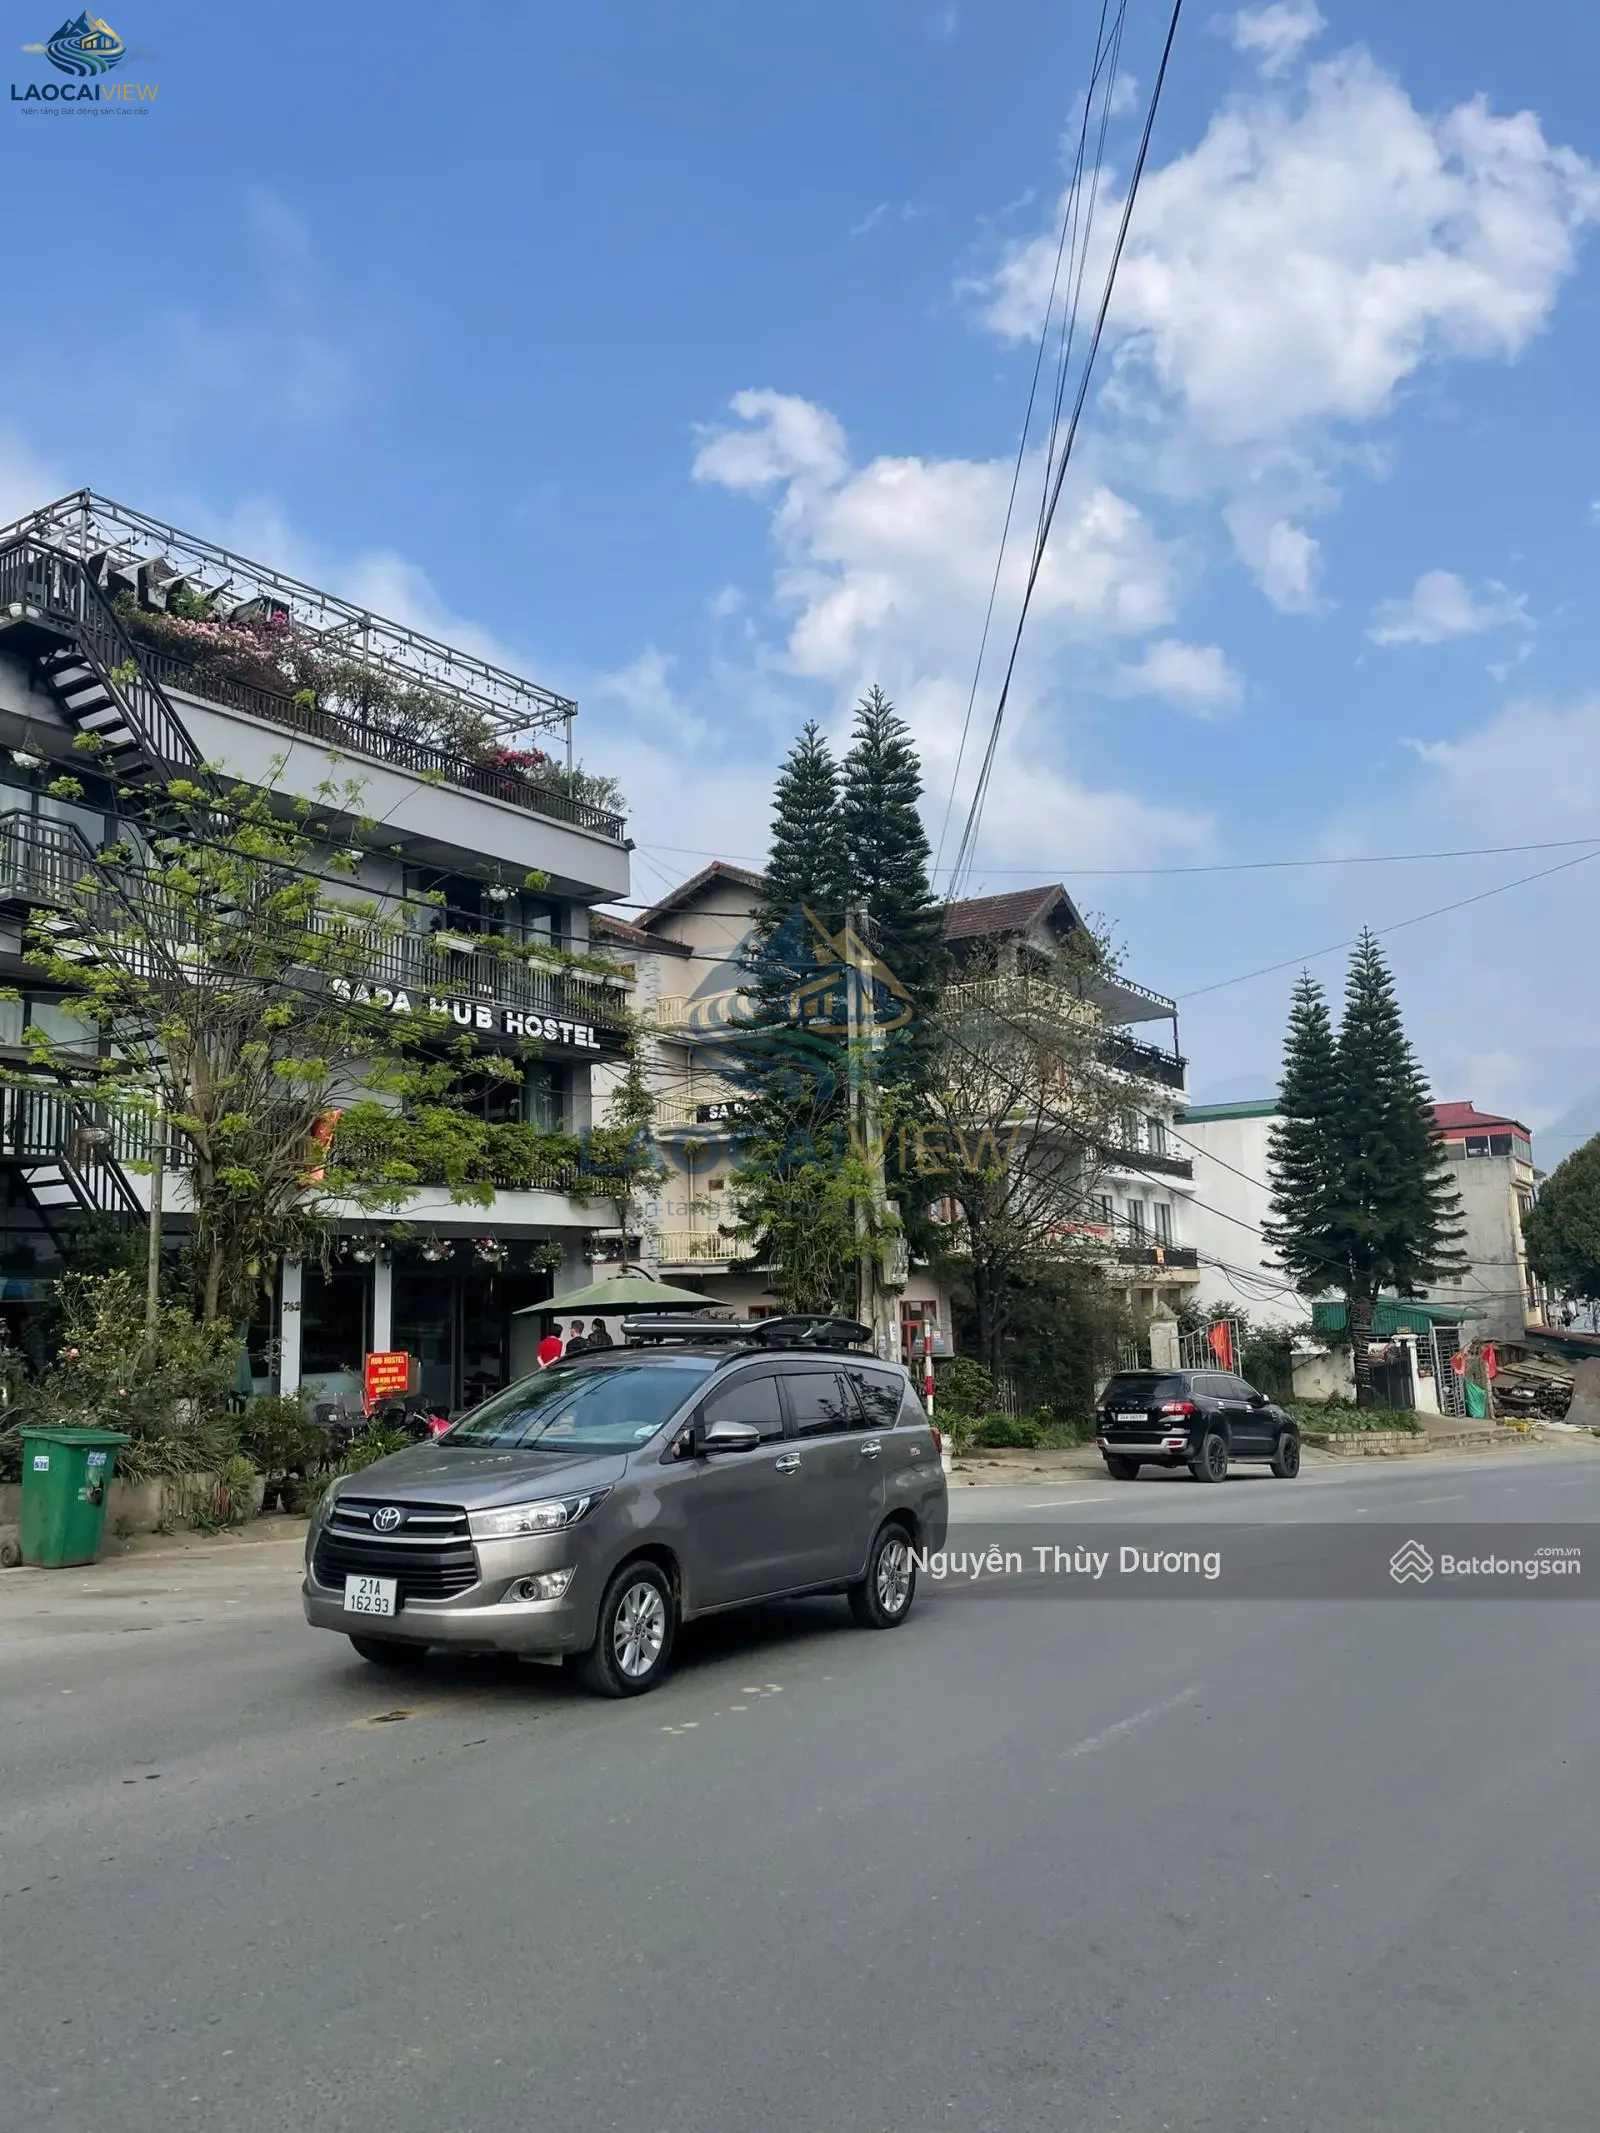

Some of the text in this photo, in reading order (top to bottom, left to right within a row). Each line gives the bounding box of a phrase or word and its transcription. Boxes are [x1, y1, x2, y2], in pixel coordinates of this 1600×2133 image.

[429, 997, 493, 1029] HUB
[506, 1011, 601, 1049] HOSTEL
[359, 1579, 381, 1595] 21A
[351, 1594, 389, 1613] 162.93
